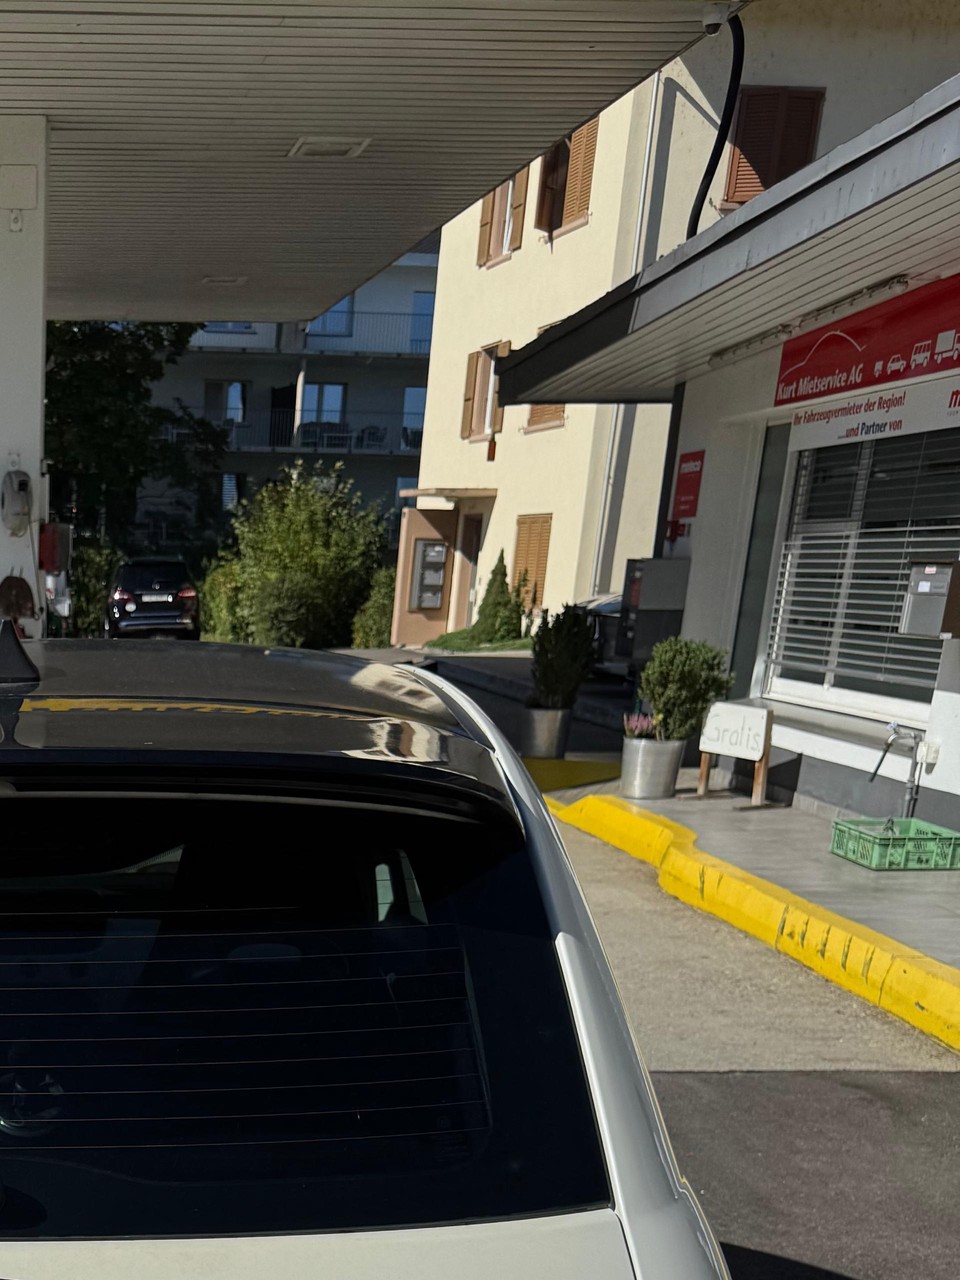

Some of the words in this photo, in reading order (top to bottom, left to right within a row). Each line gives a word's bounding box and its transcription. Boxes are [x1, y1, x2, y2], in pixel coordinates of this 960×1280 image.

[776, 381, 796, 400] Kurt
[797, 369, 847, 396] Mietservice
[847, 363, 864, 385] AG
[794, 413, 802, 425] Ihr
[803, 401, 864, 424] Fahrzeugvermieter
[864, 399, 876, 413] der
[877, 391, 906, 413] Region!
[860, 421, 888, 436] Partner
[889, 419, 902, 431] von
